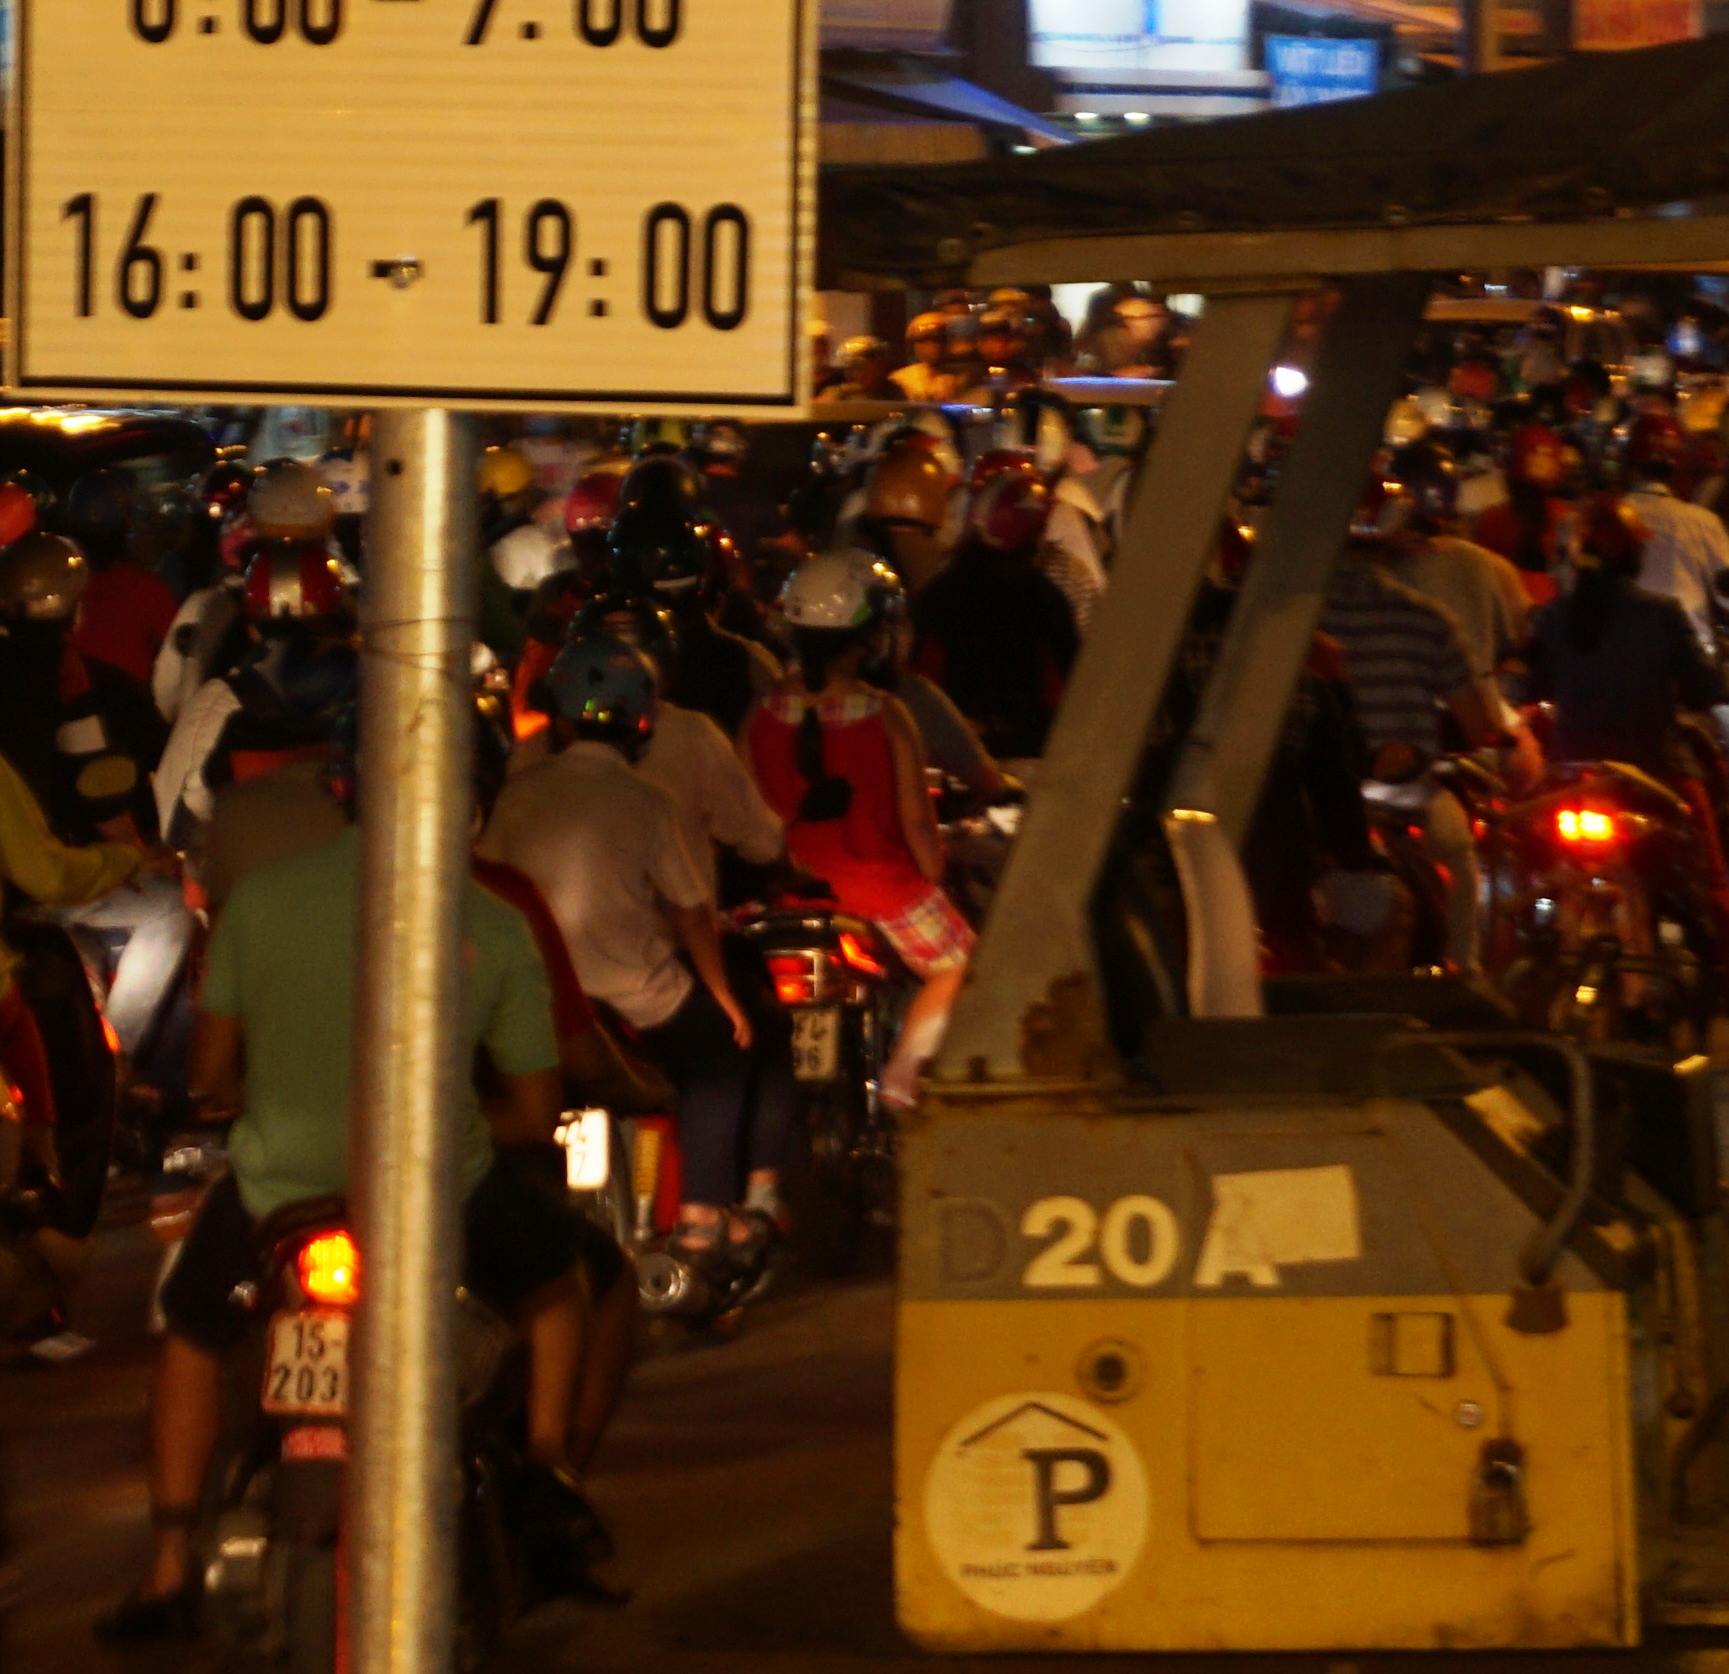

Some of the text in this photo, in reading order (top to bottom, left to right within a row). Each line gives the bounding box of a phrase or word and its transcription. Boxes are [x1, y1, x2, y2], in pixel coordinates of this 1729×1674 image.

[62, 192, 333, 324] 16:00
[467, 197, 752, 333] 19:00
[1018, 1445, 1112, 1552] P
